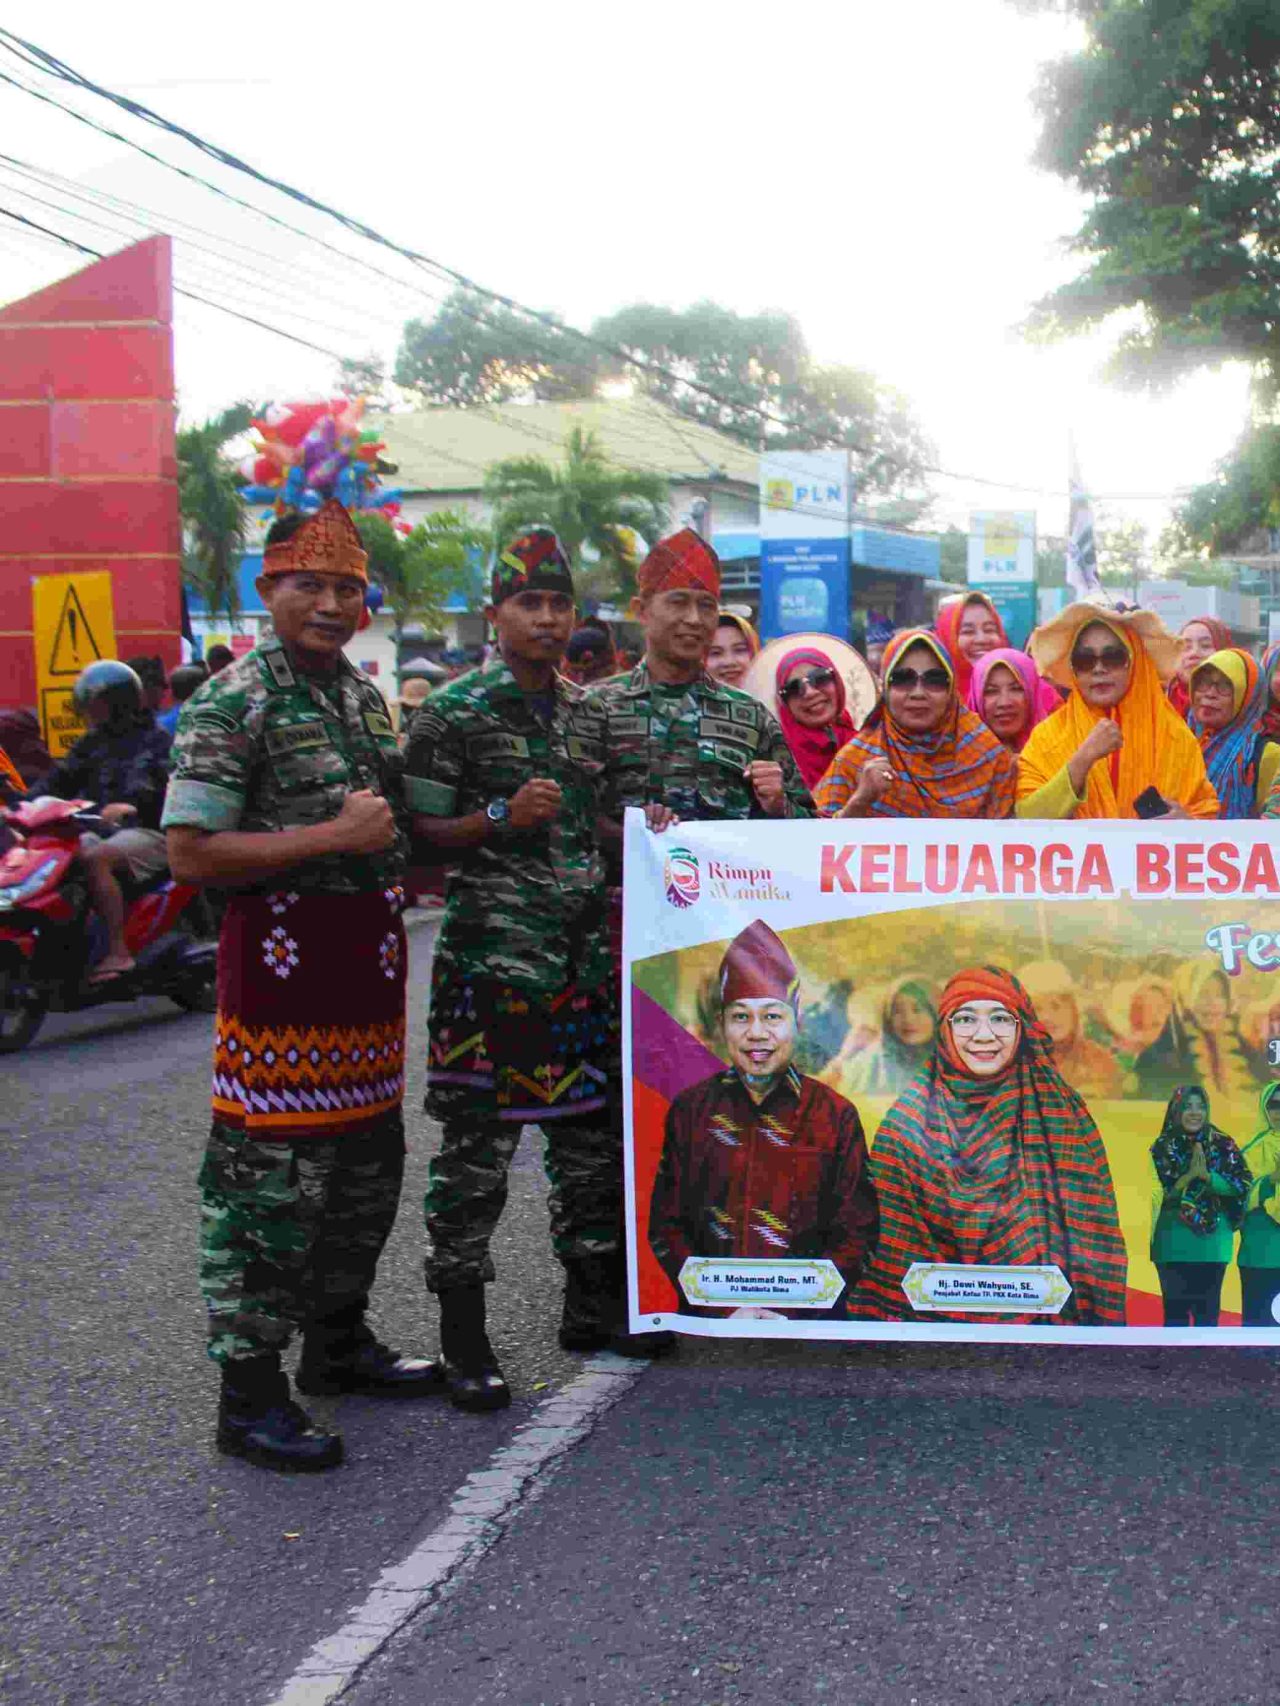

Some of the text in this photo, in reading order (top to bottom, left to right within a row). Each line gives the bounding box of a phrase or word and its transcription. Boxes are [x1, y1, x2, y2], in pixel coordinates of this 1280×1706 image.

[796, 485, 841, 502] PLN
[983, 560, 1016, 572] PLN
[708, 861, 772, 885] Rimpu
[819, 842, 1115, 895] KELUARGA
[713, 1274, 723, 1282] H.
[725, 1274, 775, 1284] Mohammad
[778, 1276, 800, 1286] Rum,
[802, 1276, 818, 1285] MT.
[938, 1280, 1034, 1291] Hj. Dewi Wahyuni, SE.
